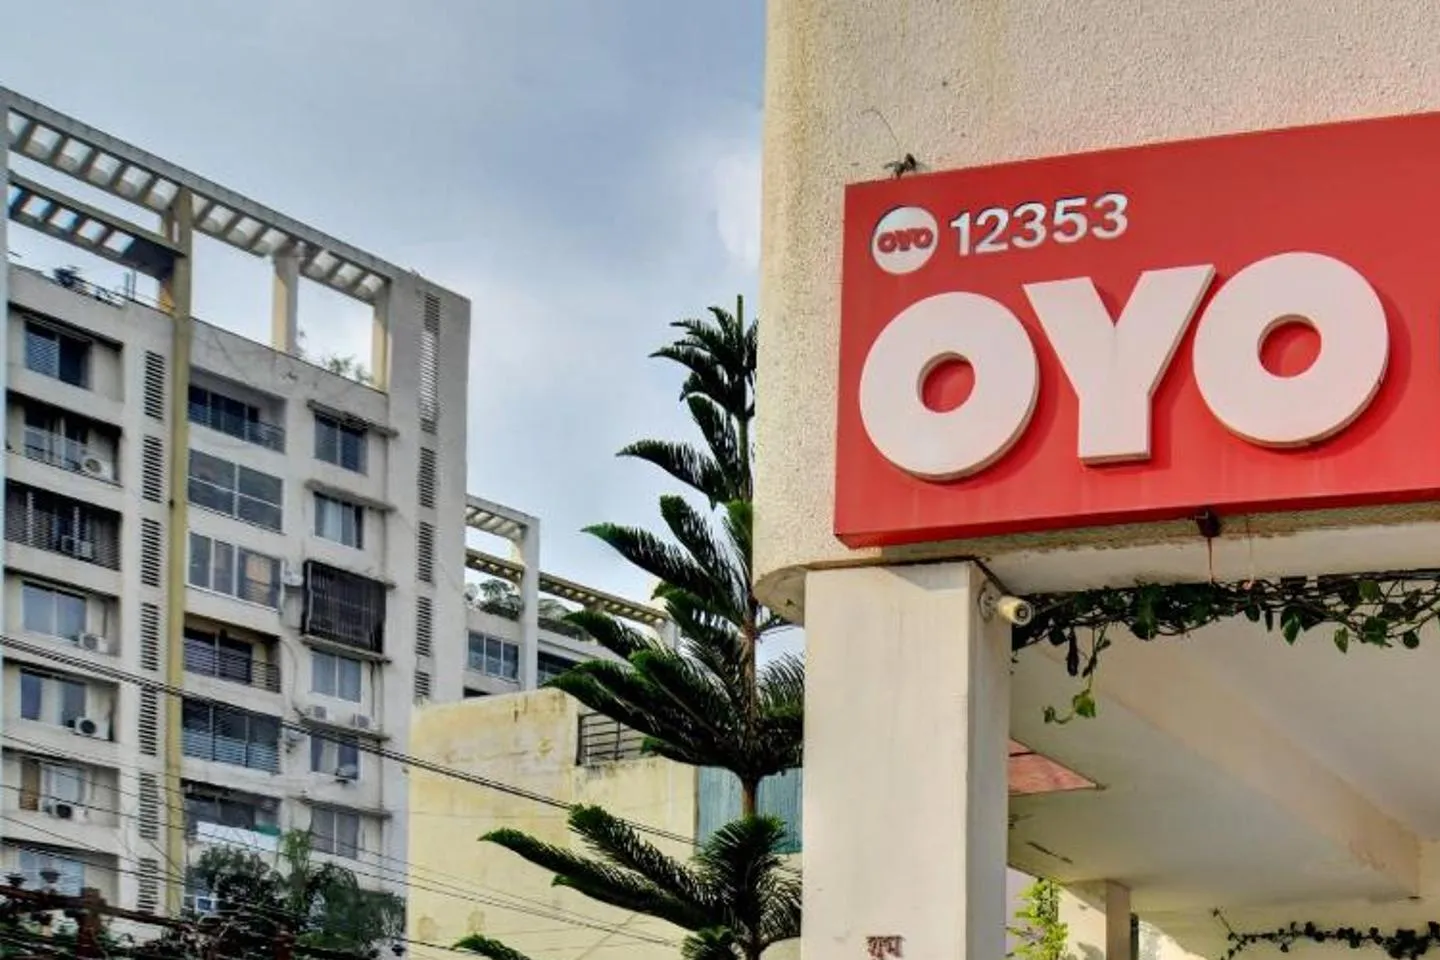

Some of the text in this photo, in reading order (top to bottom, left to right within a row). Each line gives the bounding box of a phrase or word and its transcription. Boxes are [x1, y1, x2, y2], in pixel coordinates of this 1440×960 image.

[877, 193, 1129, 256] OYO 12353
[859, 251, 1389, 481] OYO
